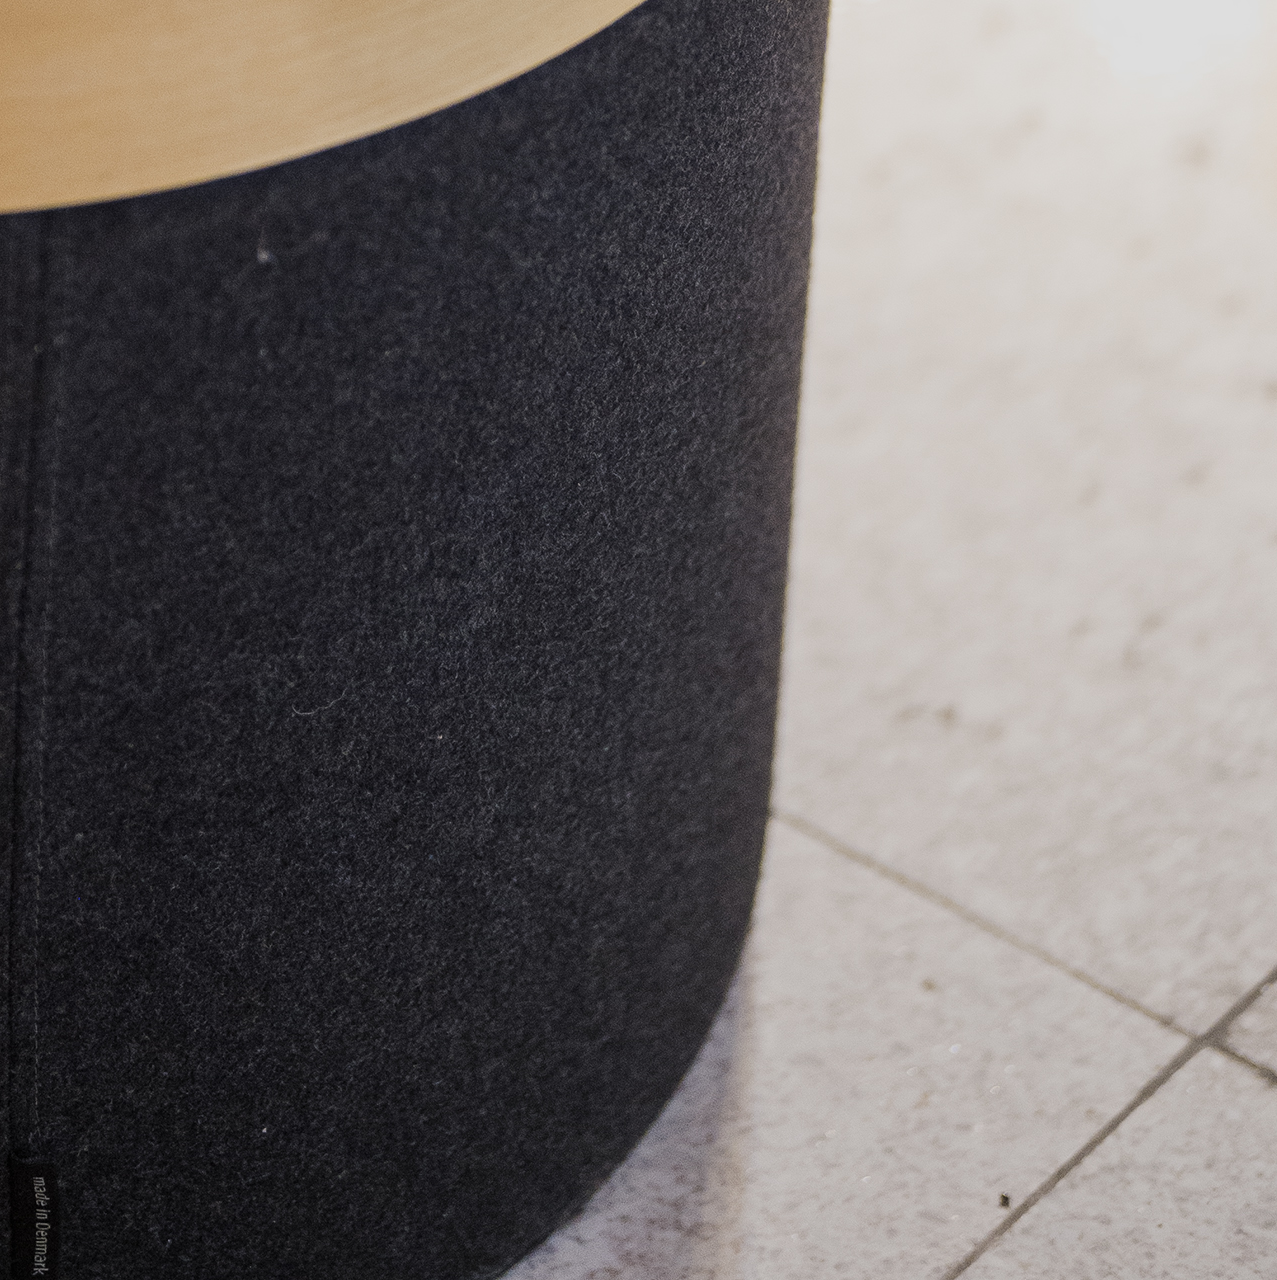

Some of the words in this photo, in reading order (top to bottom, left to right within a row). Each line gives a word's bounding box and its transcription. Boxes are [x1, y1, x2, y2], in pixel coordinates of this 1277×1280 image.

[32, 1176, 51, 1207] made
[35, 1208, 51, 1220] in
[31, 1222, 51, 1276] Denmark
